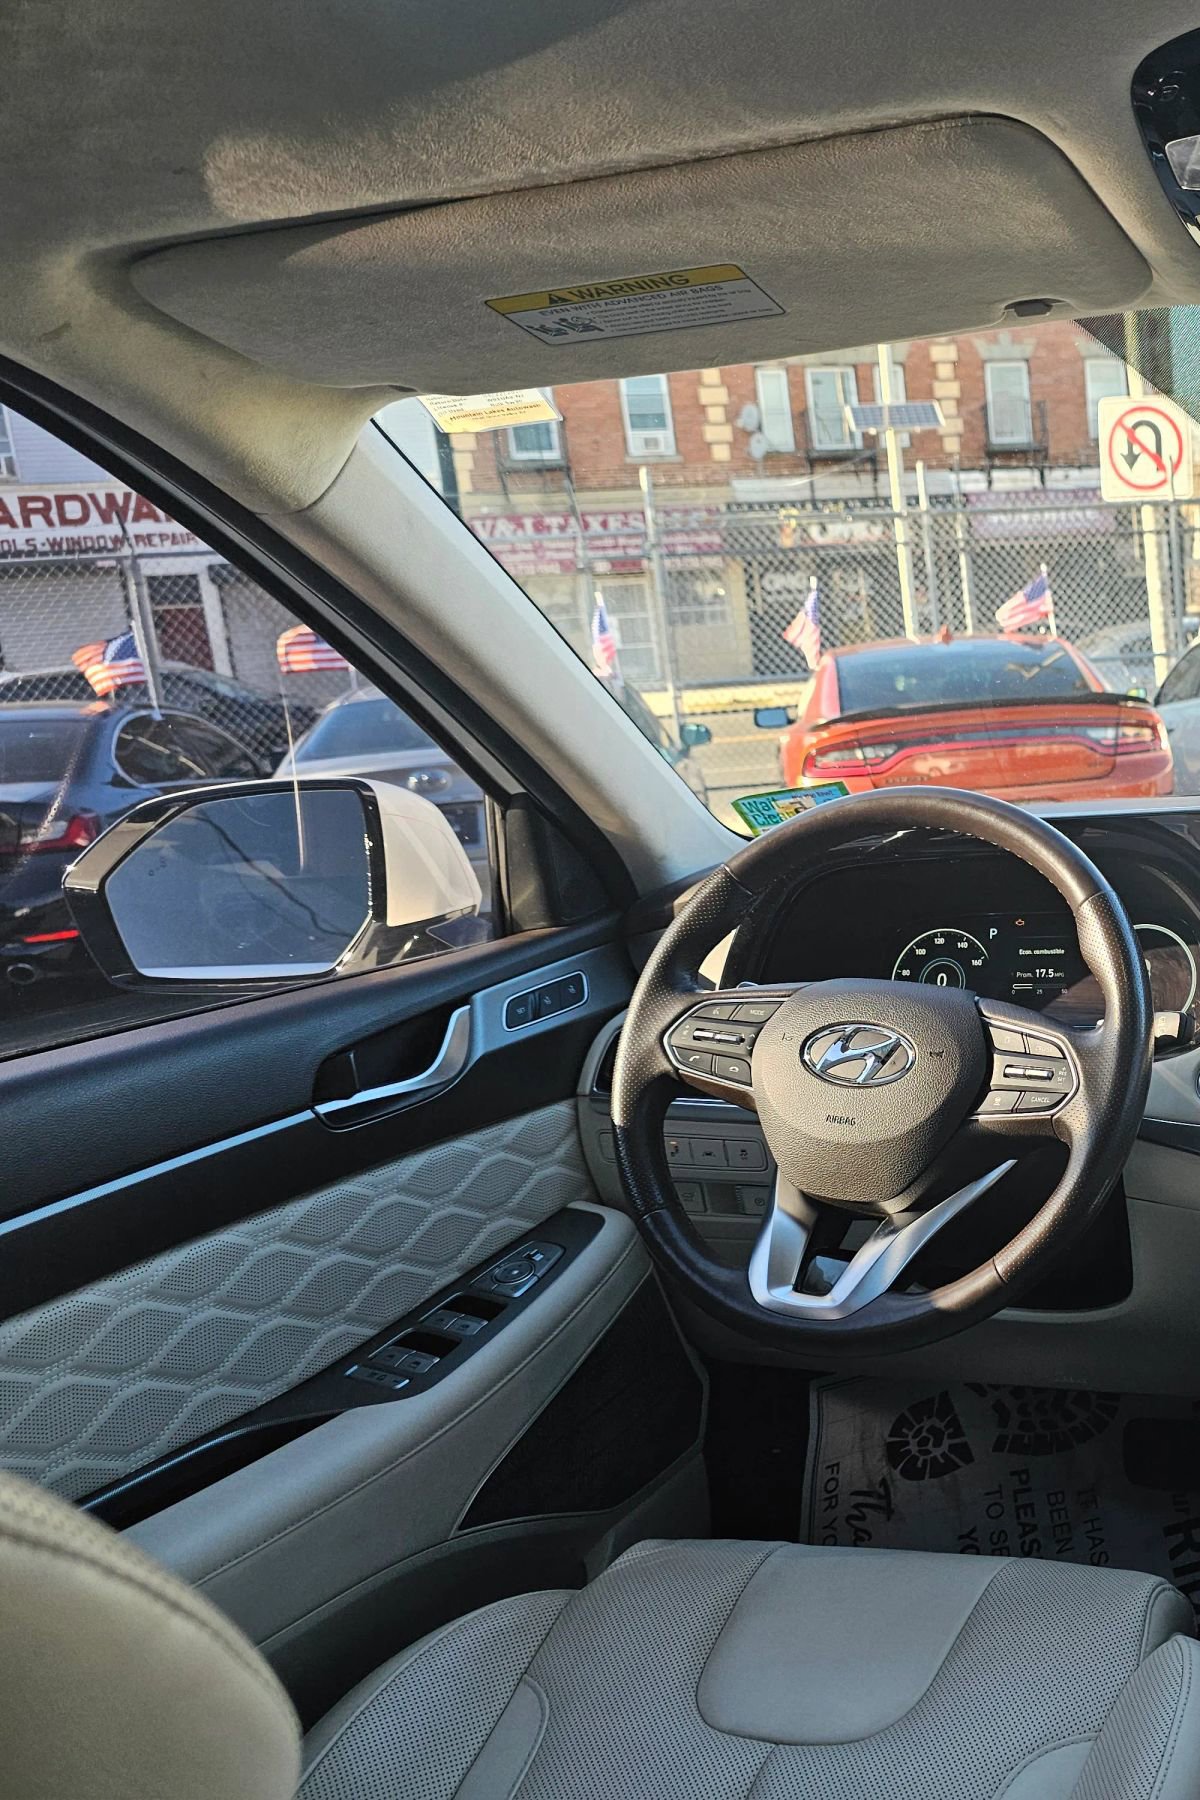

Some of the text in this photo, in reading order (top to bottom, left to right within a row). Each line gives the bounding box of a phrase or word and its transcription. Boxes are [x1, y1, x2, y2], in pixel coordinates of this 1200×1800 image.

[539, 306, 570, 316] EVEN
[571, 302, 603, 313] WITH
[603, 293, 666, 307] ADVANCED
[669, 289, 689, 299] AIR
[691, 284, 723, 295] BAGS
[568, 274, 690, 301] WARNING
[0, 491, 174, 529] ARDWA
[46, 534, 127, 551] WINDOW
[989, 927, 998, 940] P
[937, 972, 948, 987] 0
[1035, 968, 1055, 978] 17.5
[825, 1114, 856, 1126] AIRBAG
[822, 1461, 842, 1512] FOR
[984, 1483, 1005, 1521] TO
[1009, 1468, 1043, 1560] PLEAS
[1046, 1489, 1074, 1555] BEEN
